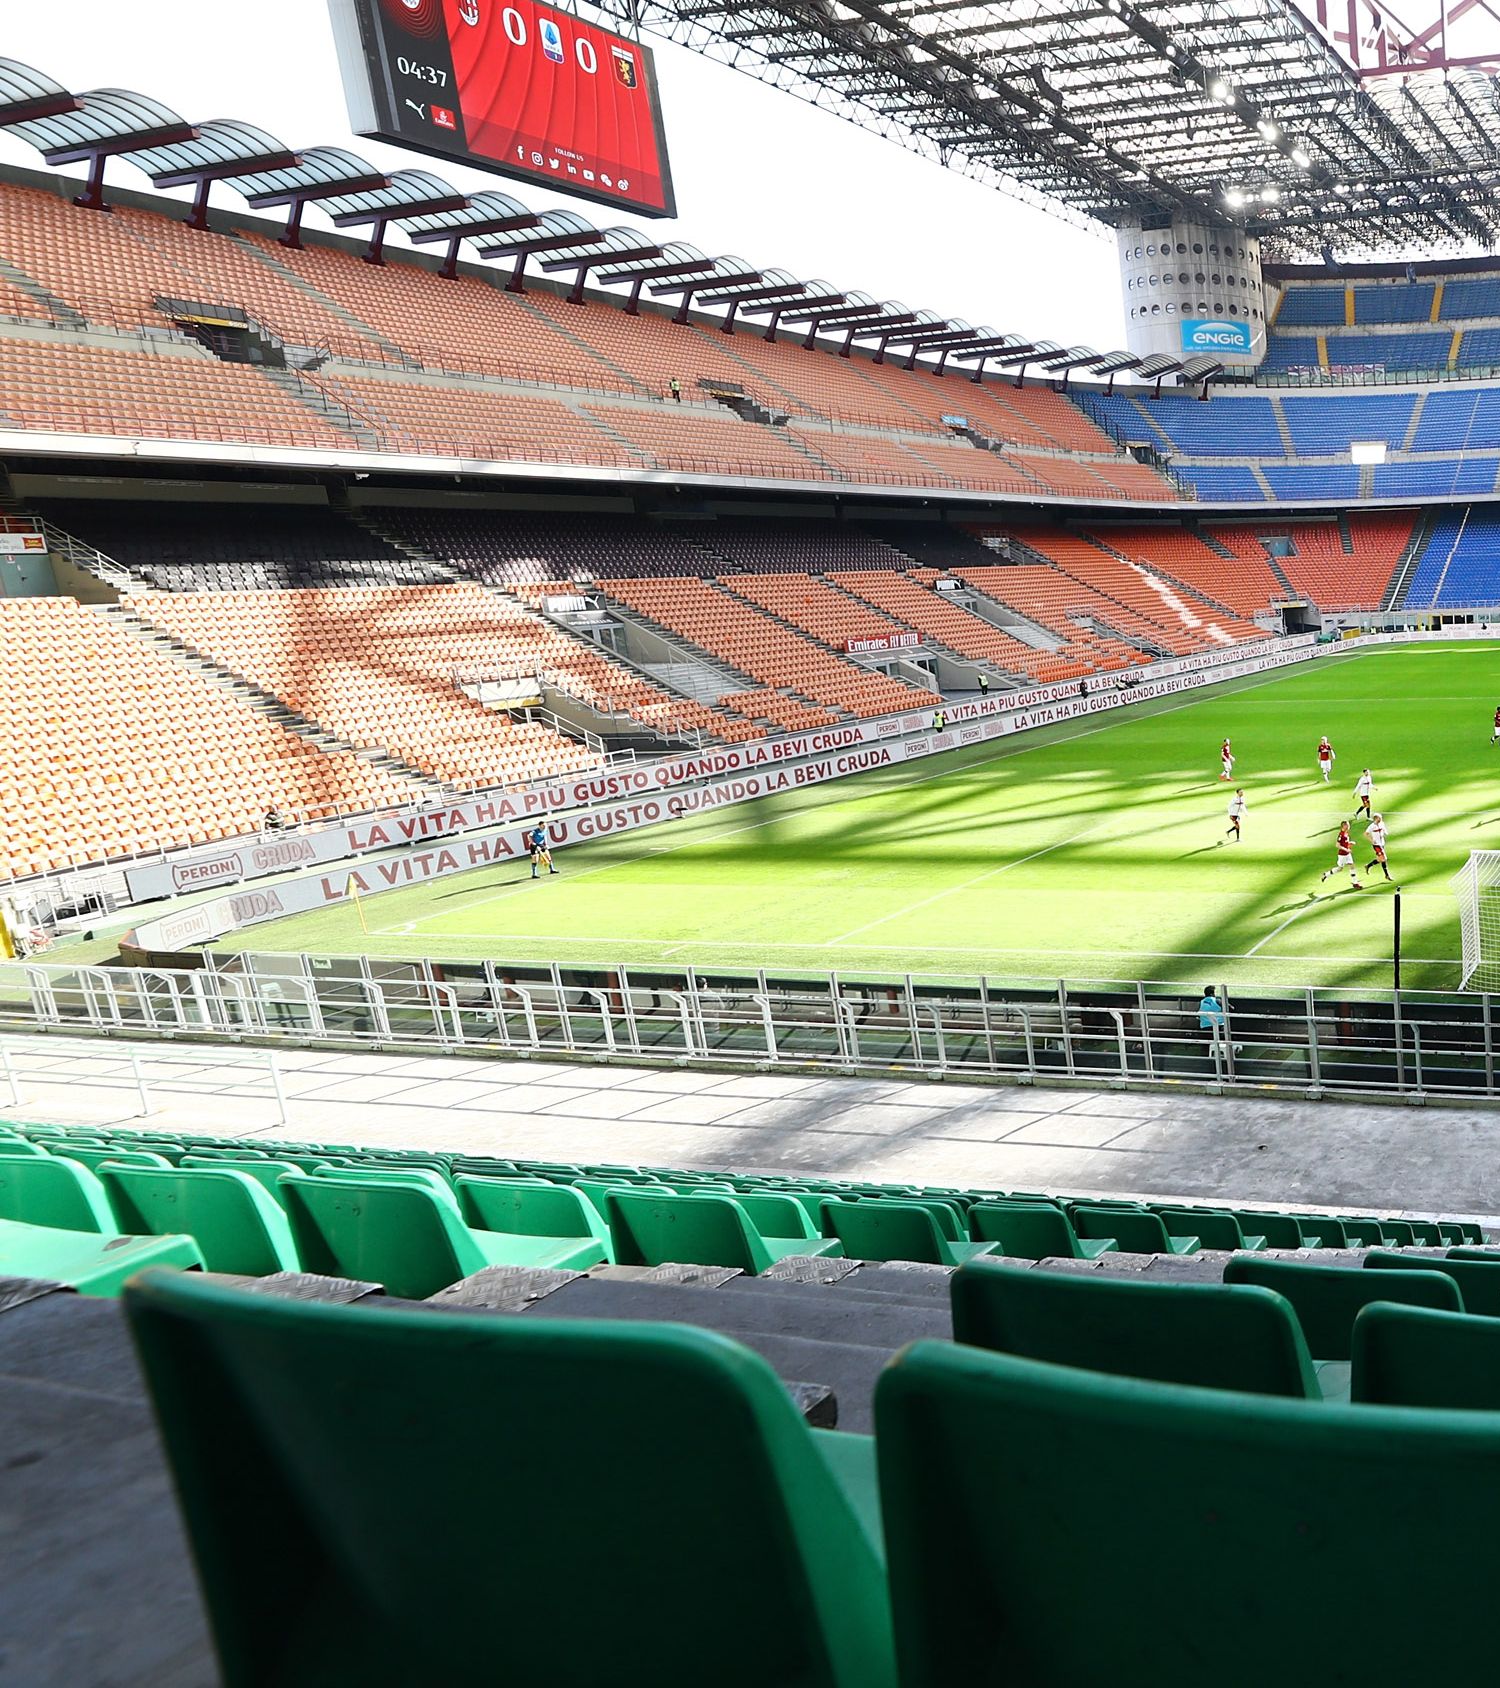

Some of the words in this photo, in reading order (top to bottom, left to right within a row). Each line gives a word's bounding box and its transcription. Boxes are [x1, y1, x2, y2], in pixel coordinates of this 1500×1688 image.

[503, 7, 526, 46] 0
[397, 56, 446, 87] 04:37
[576, 38, 597, 74] 0
[848, 638, 888, 652] Emirates
[890, 635, 899, 647] FLY
[952, 703, 978, 721] VITA
[981, 700, 996, 714] HA
[1019, 689, 1049, 706] GUSTO
[1090, 680, 1100, 690] LA
[1014, 716, 1028, 730] LA
[1029, 709, 1054, 726] VITA
[1056, 706, 1070, 719] HA
[1090, 695, 1118, 710] GUSTO
[1120, 687, 1154, 705] QUANDO
[1156, 683, 1165, 694] LA
[1167, 680, 1182, 692] BEVI
[1184, 675, 1206, 688] CRUDA
[907, 741, 927, 753] PERONI
[348, 825, 390, 850] LA
[398, 810, 468, 838] VITA
[476, 800, 516, 823] HA
[524, 786, 566, 813] PIÙ
[574, 772, 648, 800] GUSTO
[655, 753, 740, 786] QUANDO
[746, 748, 768, 764] LA
[773, 739, 807, 760] BEVI
[812, 728, 864, 749] CRUDA
[320, 870, 370, 900] LA
[378, 850, 459, 884] VITA
[467, 840, 514, 864] HA
[577, 802, 660, 837] GUSTO
[668, 778, 760, 816] QUANDO
[766, 772, 790, 791] LA
[795, 760, 832, 784] BEVI
[837, 748, 891, 773] CRUDA
[180, 860, 236, 881] PERONI
[252, 839, 315, 870] CRUDA
[216, 890, 284, 927] CRUDA
[166, 920, 204, 941] PERONI
